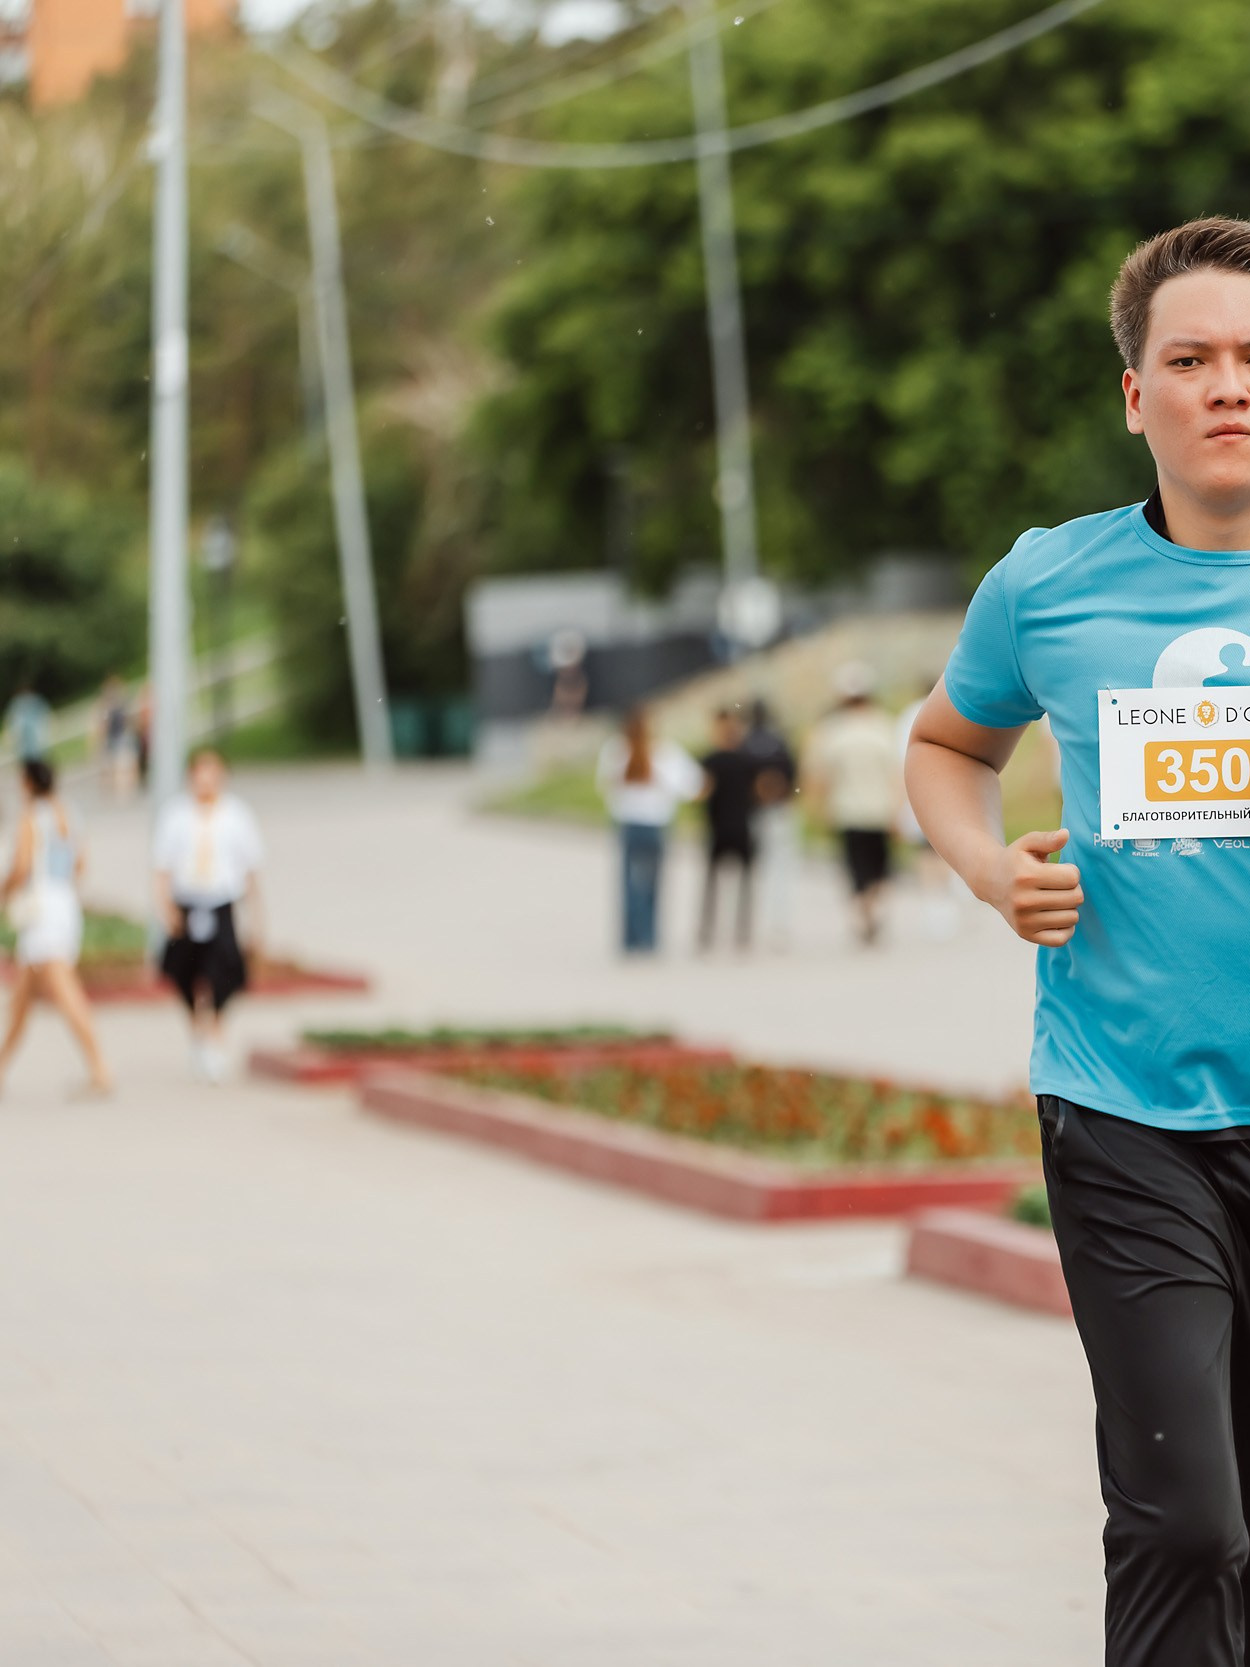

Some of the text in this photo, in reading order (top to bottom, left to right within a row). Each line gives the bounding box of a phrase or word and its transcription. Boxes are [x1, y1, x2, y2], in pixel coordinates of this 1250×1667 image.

[1118, 708, 1187, 726] LEONE
[1156, 747, 1250, 794] 350
[1122, 808, 1250, 822] БЛАГОТВОРИТЕЛЬНЫЙ
